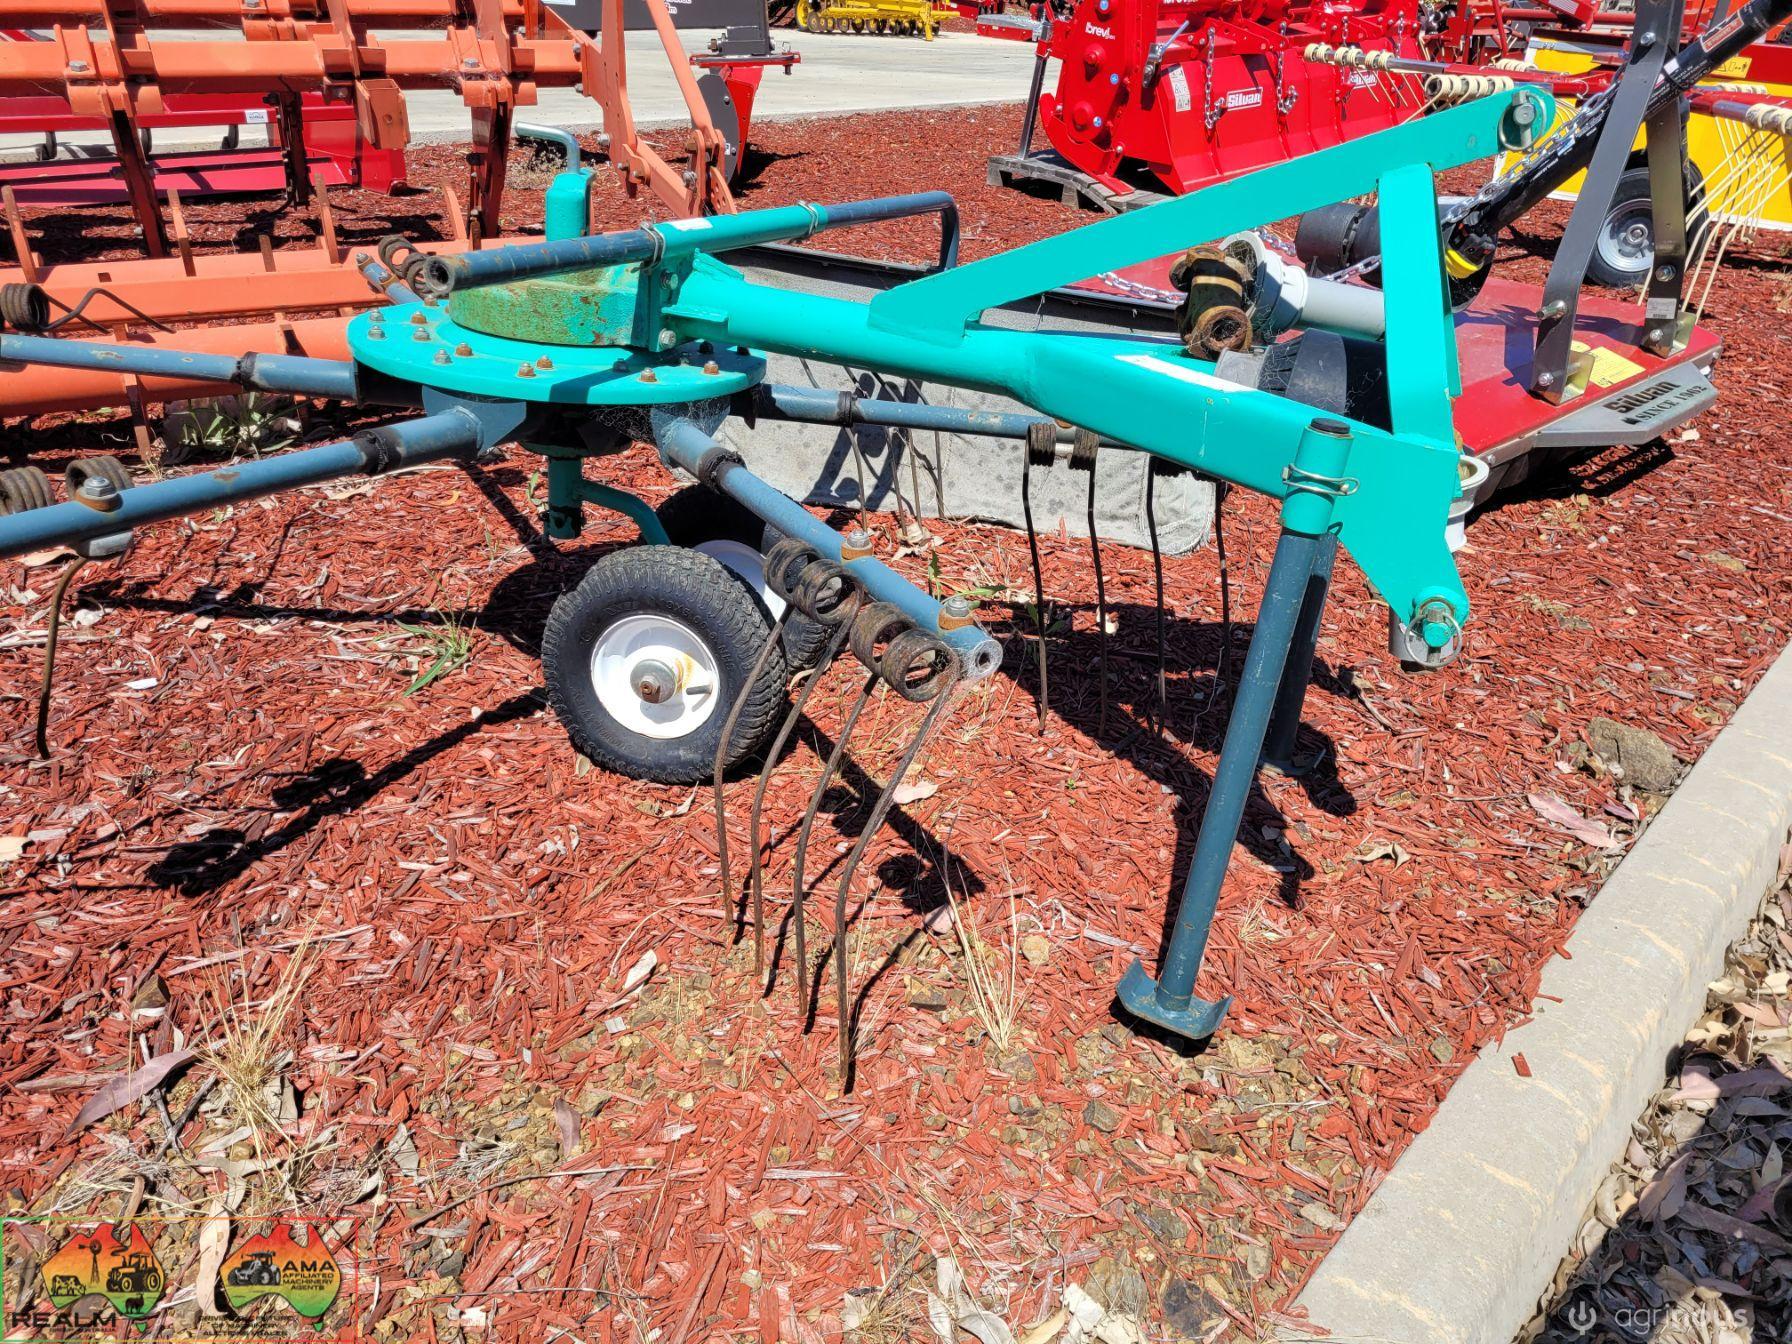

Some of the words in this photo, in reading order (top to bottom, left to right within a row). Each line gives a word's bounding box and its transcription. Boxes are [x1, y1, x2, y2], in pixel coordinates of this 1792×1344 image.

[1228, 92, 1261, 107] Silvan
[1603, 381, 1682, 413] Silvan
[1636, 399, 1681, 420] SINCE
